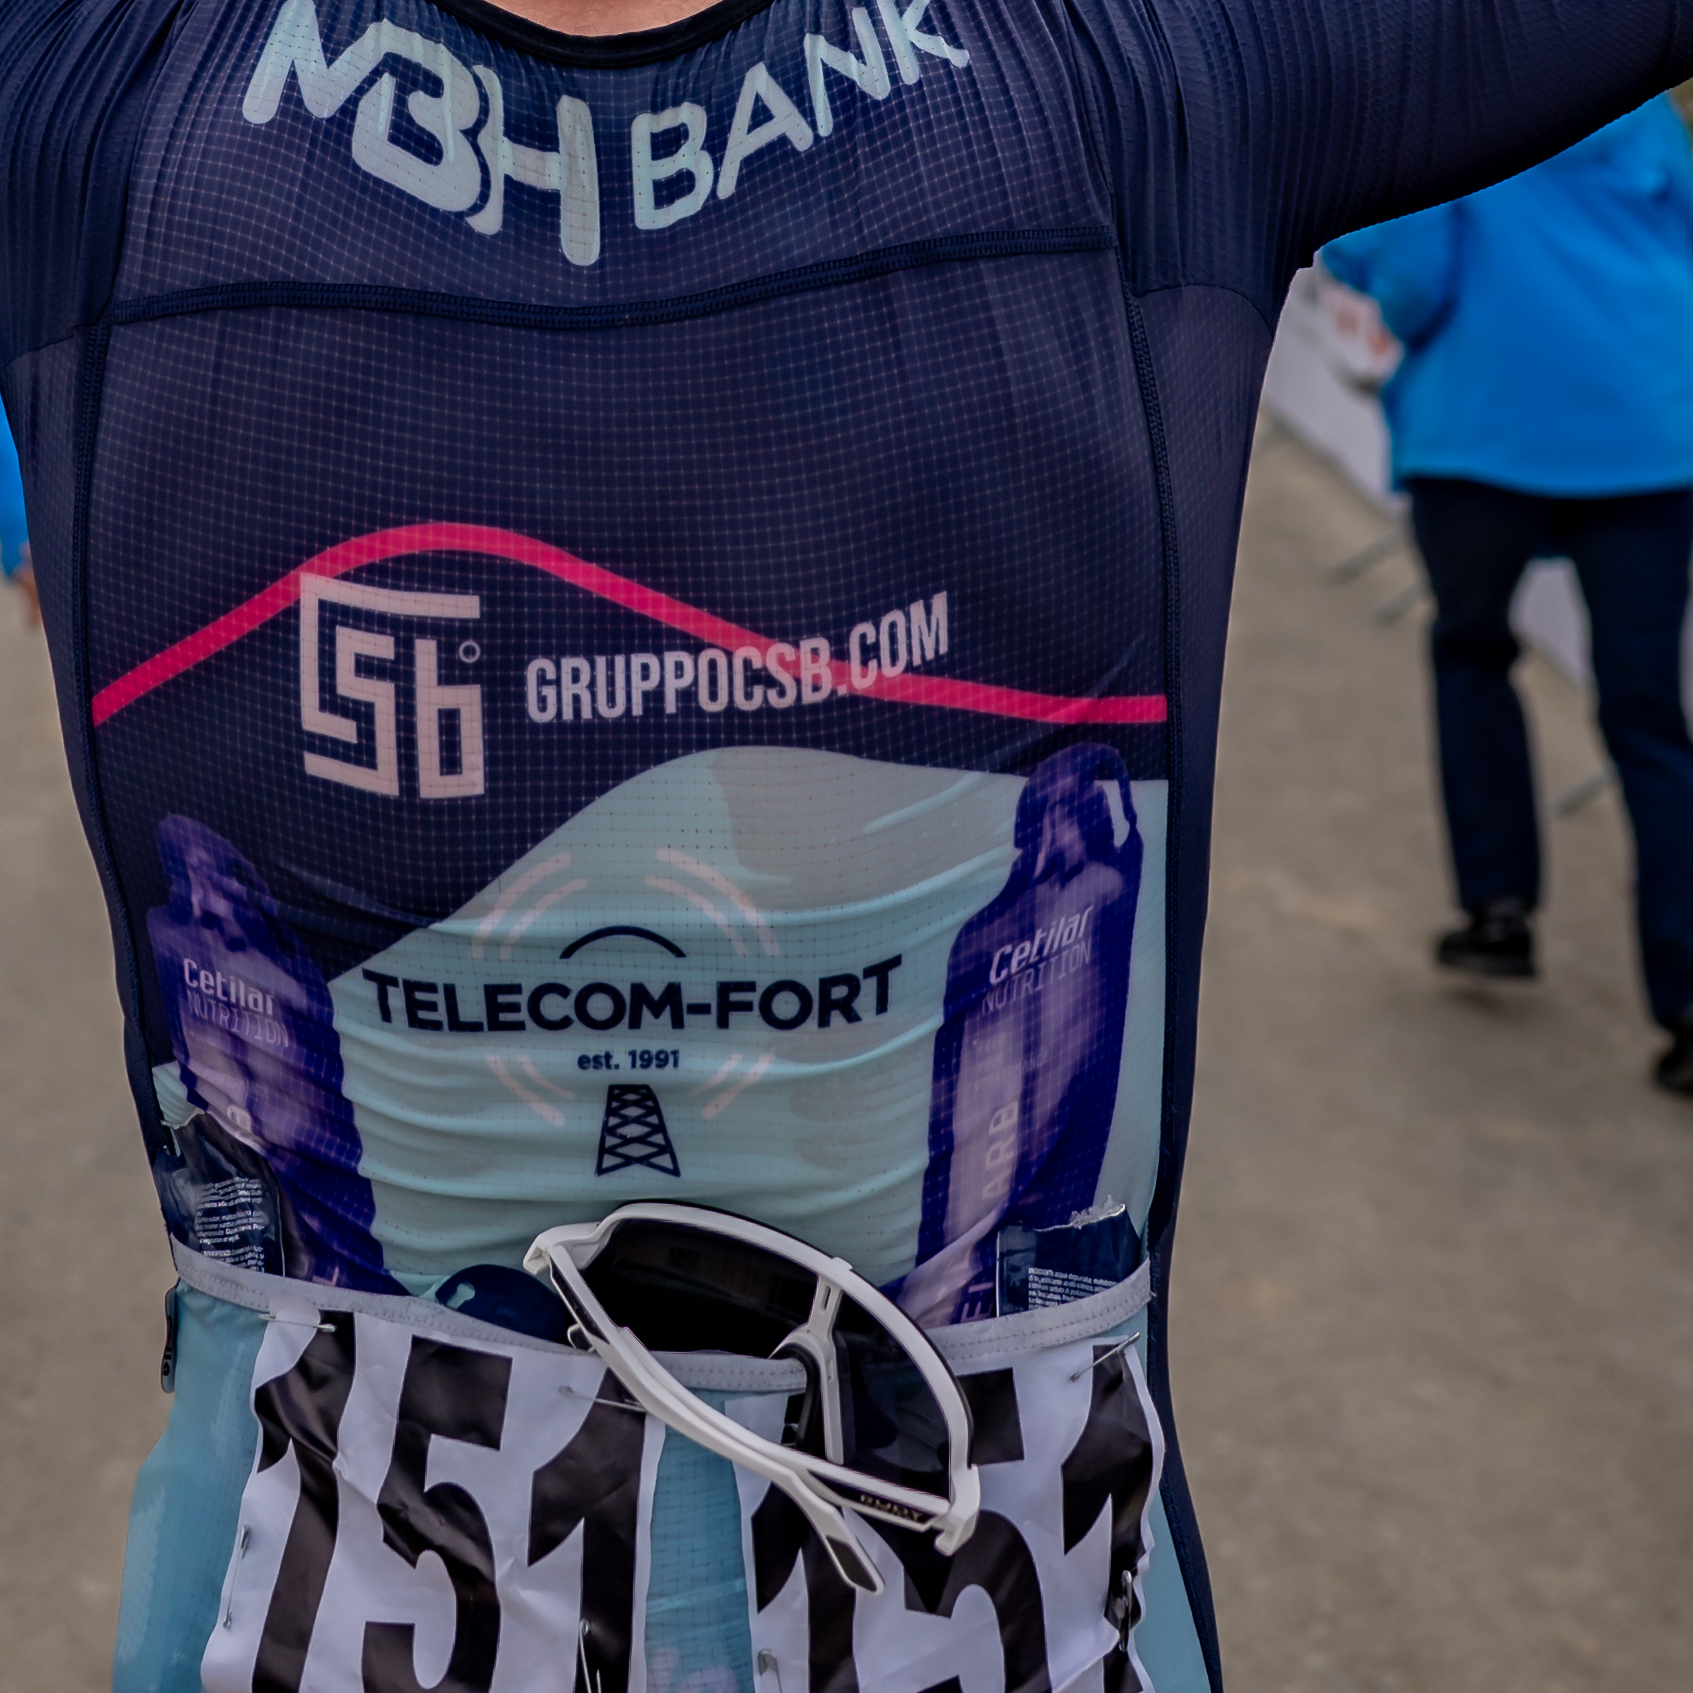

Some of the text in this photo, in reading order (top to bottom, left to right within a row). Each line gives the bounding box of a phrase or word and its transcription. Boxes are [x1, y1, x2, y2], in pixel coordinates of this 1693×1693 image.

[525, 590, 950, 724] GRUPPOCSB.COM
[981, 936, 1092, 1015] NUTRITION
[989, 905, 1095, 985] Cetilar
[183, 957, 275, 1017] Cetilar
[187, 989, 289, 1048] NUTRITION
[362, 953, 903, 1032] TELECOM-FORT
[577, 1049, 681, 1071] est. 1991
